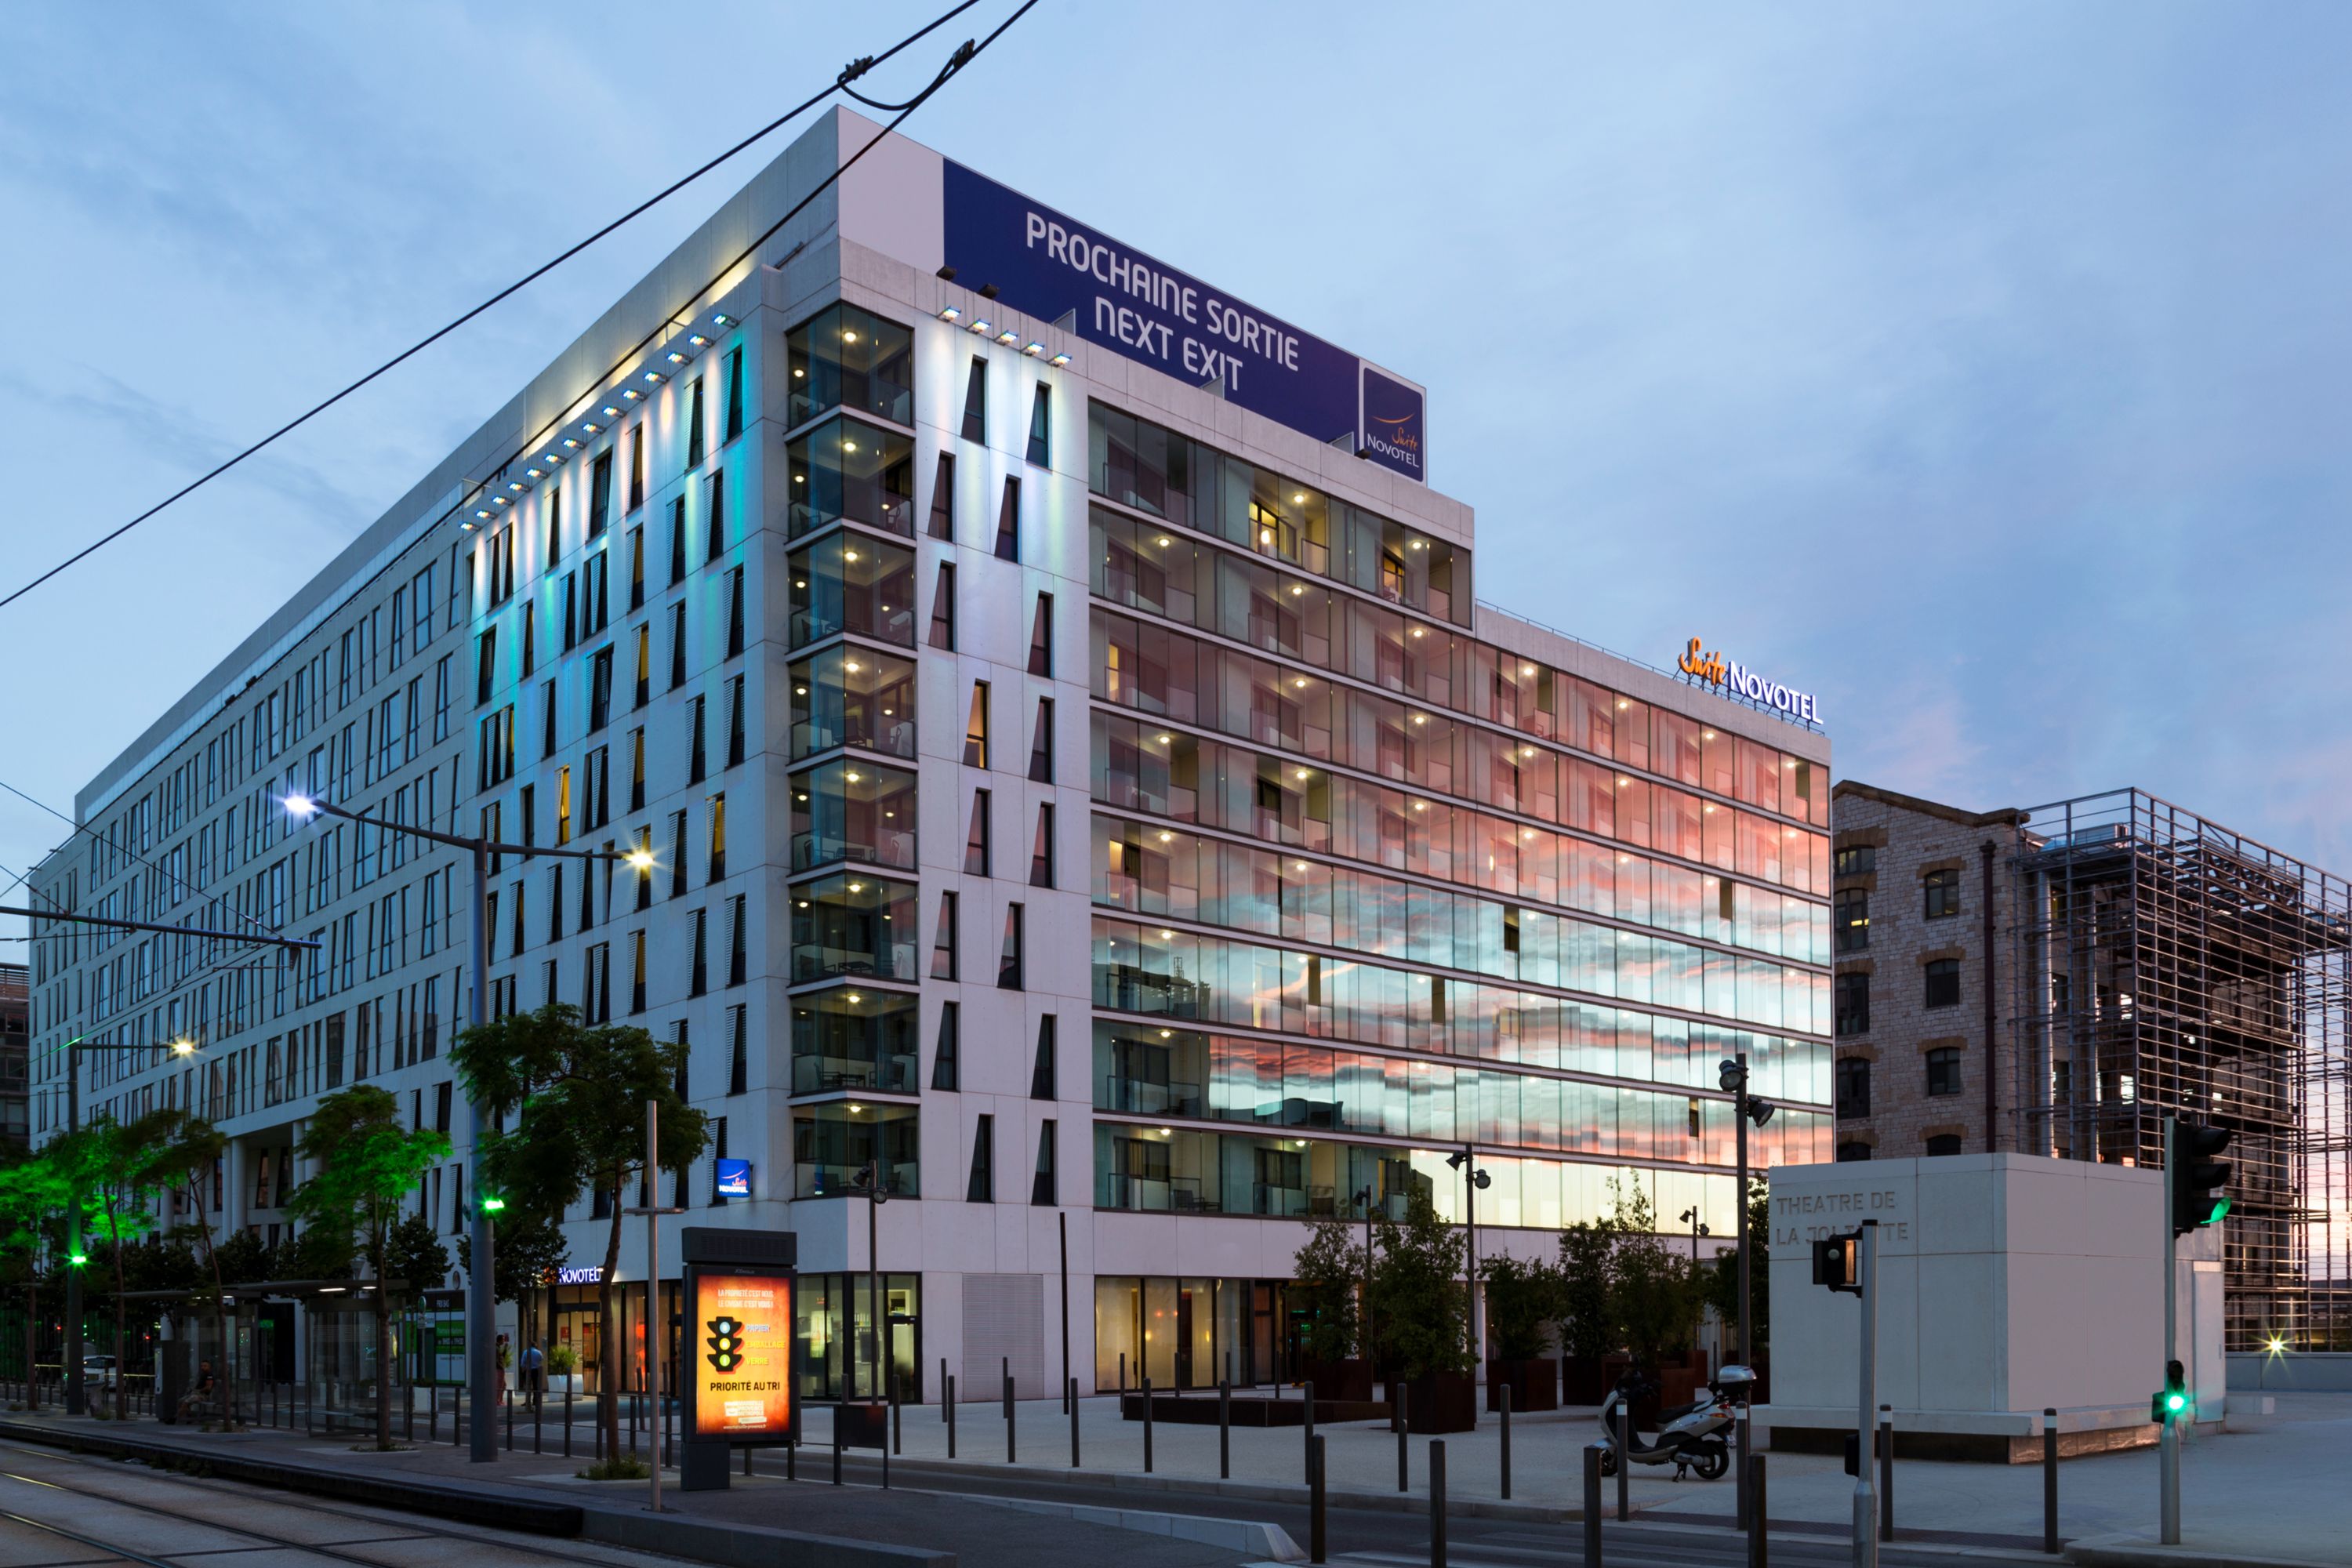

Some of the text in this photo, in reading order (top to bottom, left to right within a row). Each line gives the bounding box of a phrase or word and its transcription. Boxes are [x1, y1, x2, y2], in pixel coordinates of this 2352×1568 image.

[1027, 211, 1299, 372] PROCHAINE SORTIE
[1095, 296, 1243, 391] NEXT EXIT
[1392, 426, 1418, 452] Suite
[1367, 433, 1420, 469] NOVOTEL
[1678, 636, 1824, 725] Suite NOVOTEL
[718, 1185, 749, 1193] NOVOTEL
[1777, 1191, 1896, 1215] THEATRE DE
[1777, 1227, 1801, 1246] LA
[558, 1266, 601, 1283] NOVOTEL
[746, 1323, 770, 1333] PAPIER
[746, 1341, 786, 1349] EMBALLAGE
[746, 1357, 769, 1366] VERRE
[710, 1380, 780, 1392] PRIORITÉ AU TRI
